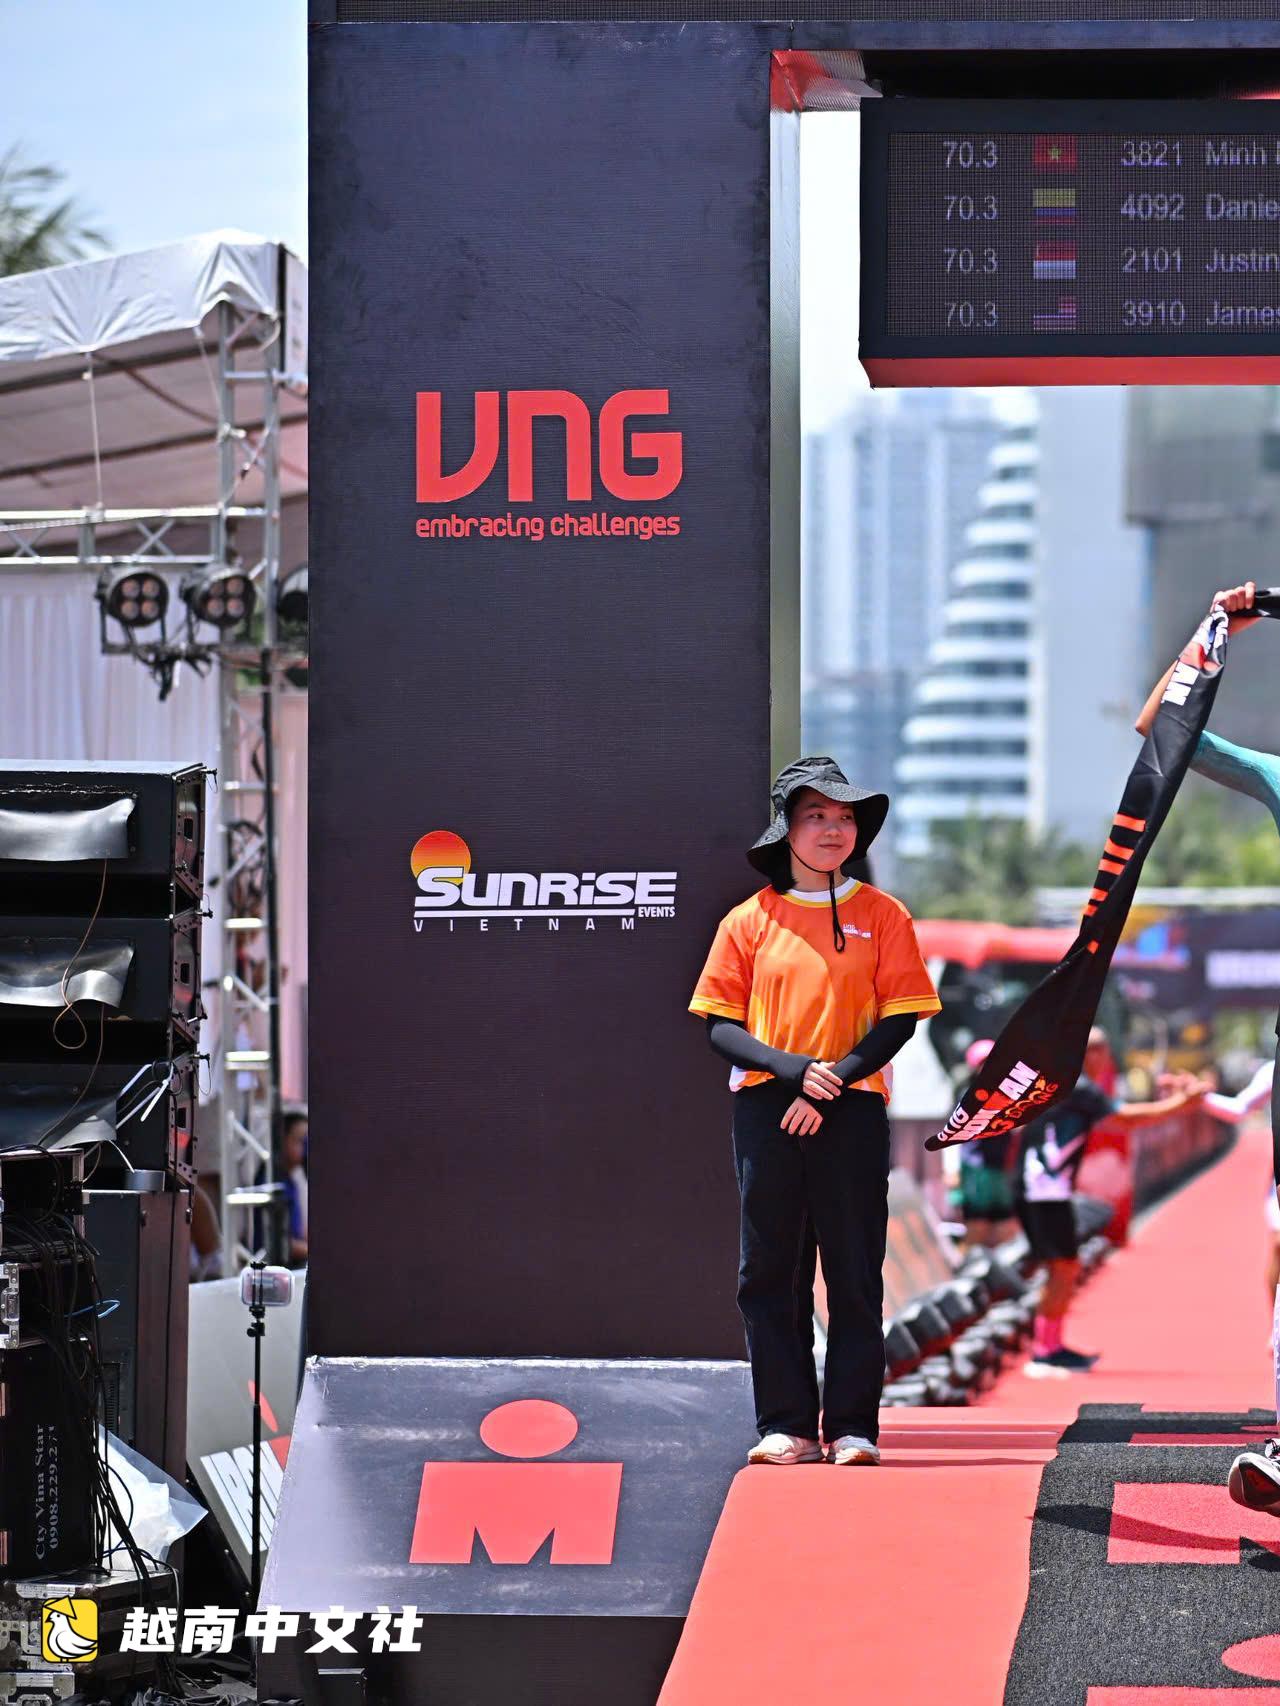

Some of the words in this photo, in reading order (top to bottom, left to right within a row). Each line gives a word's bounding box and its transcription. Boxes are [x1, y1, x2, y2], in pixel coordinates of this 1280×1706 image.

[943, 140, 998, 168] 70.3
[1121, 141, 1182, 166] 3821
[1205, 140, 1267, 166] Minh
[944, 195, 998, 220] 70.3
[1120, 193, 1185, 220] 4092
[943, 248, 998, 273] 70.3
[1122, 247, 1182, 273] 2101
[1205, 247, 1280, 273] Justin
[944, 301, 998, 327] 70.3
[1122, 300, 1185, 326] 3910
[416, 512, 545, 542] embracing
[550, 512, 681, 541] challenges
[413, 917, 635, 933] VIETNAM
[637, 906, 676, 918] EVENTS
[35, 1423, 46, 1466] Star
[36, 1472, 45, 1518] Vina
[35, 1522, 48, 1560] Cty
